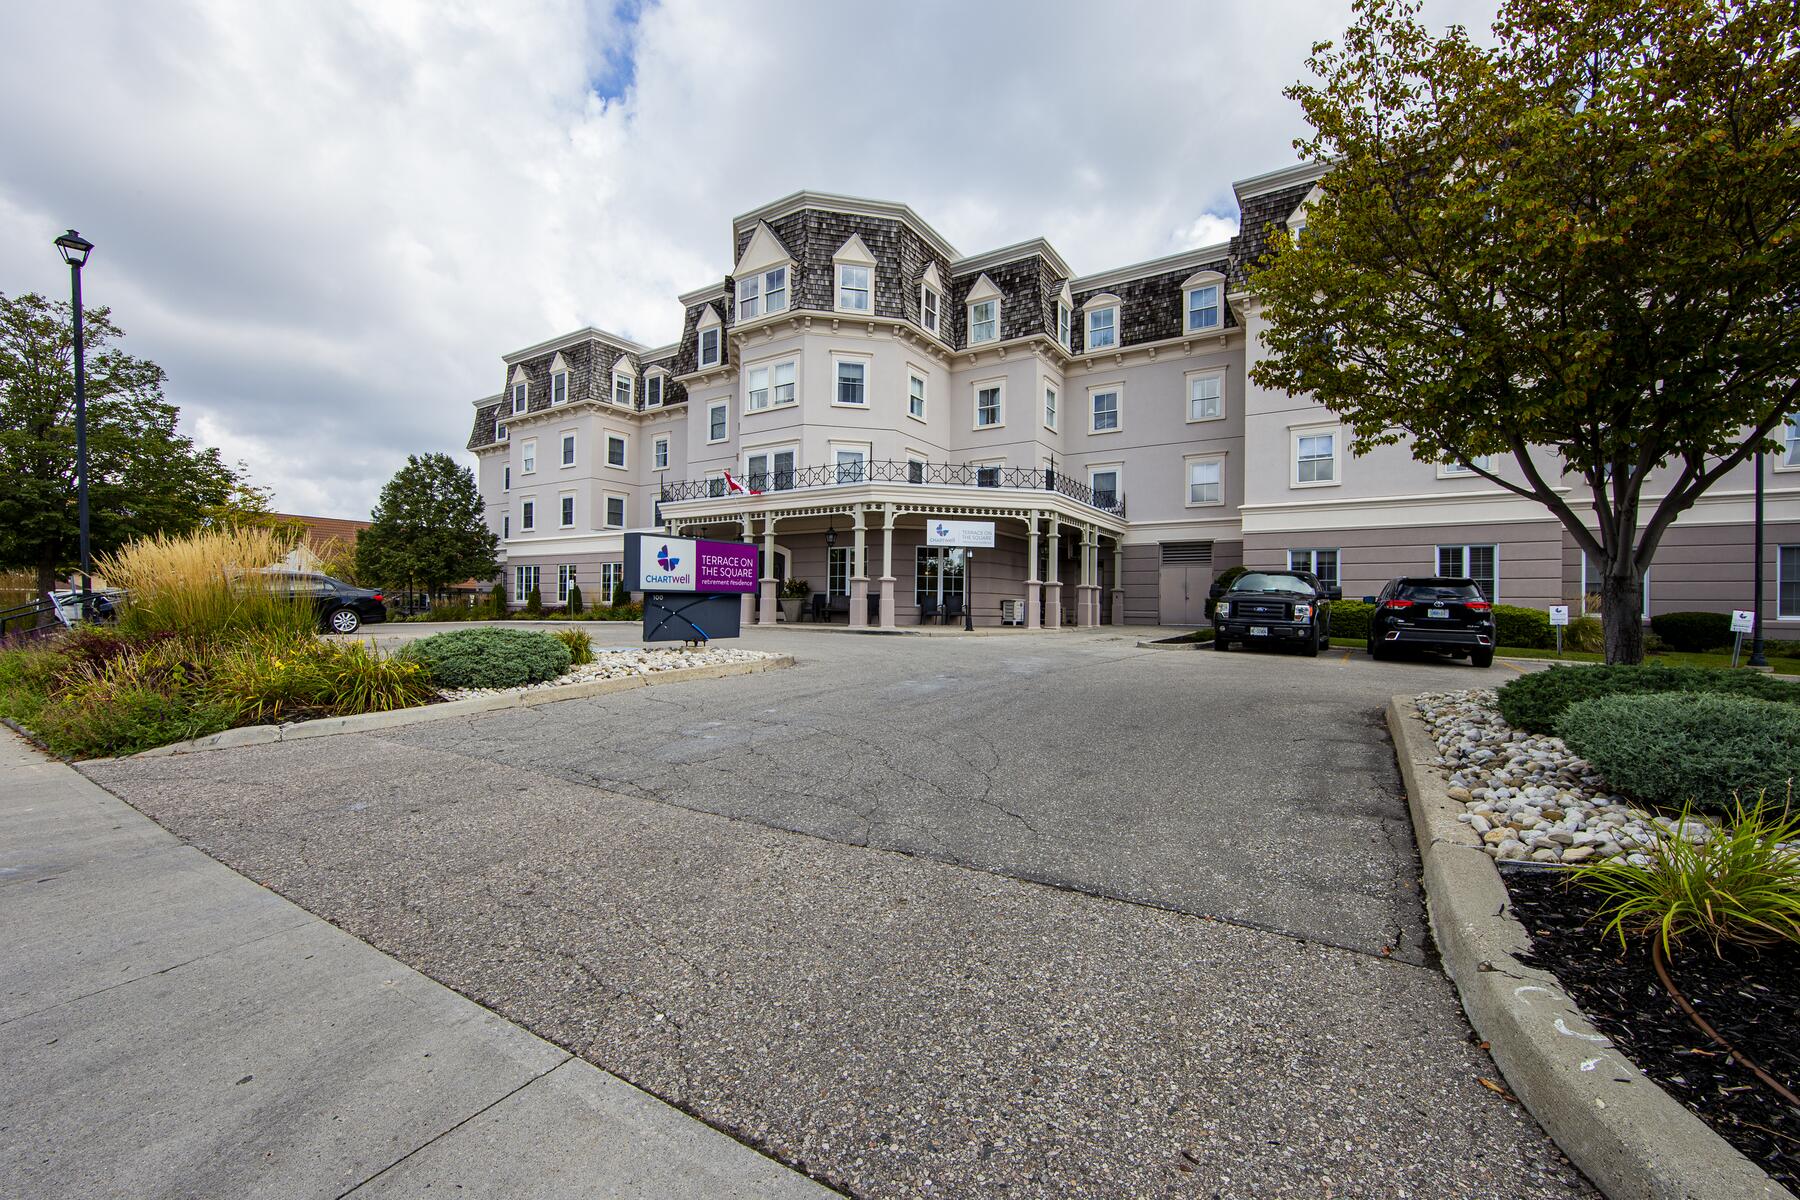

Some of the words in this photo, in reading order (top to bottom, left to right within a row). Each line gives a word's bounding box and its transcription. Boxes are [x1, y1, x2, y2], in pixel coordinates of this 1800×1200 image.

[702, 556, 738, 567] TERRACE
[740, 558, 753, 568] ON
[702, 567, 718, 576] THE
[720, 568, 753, 578] SQUARE
[646, 574, 690, 584] CHARTwell
